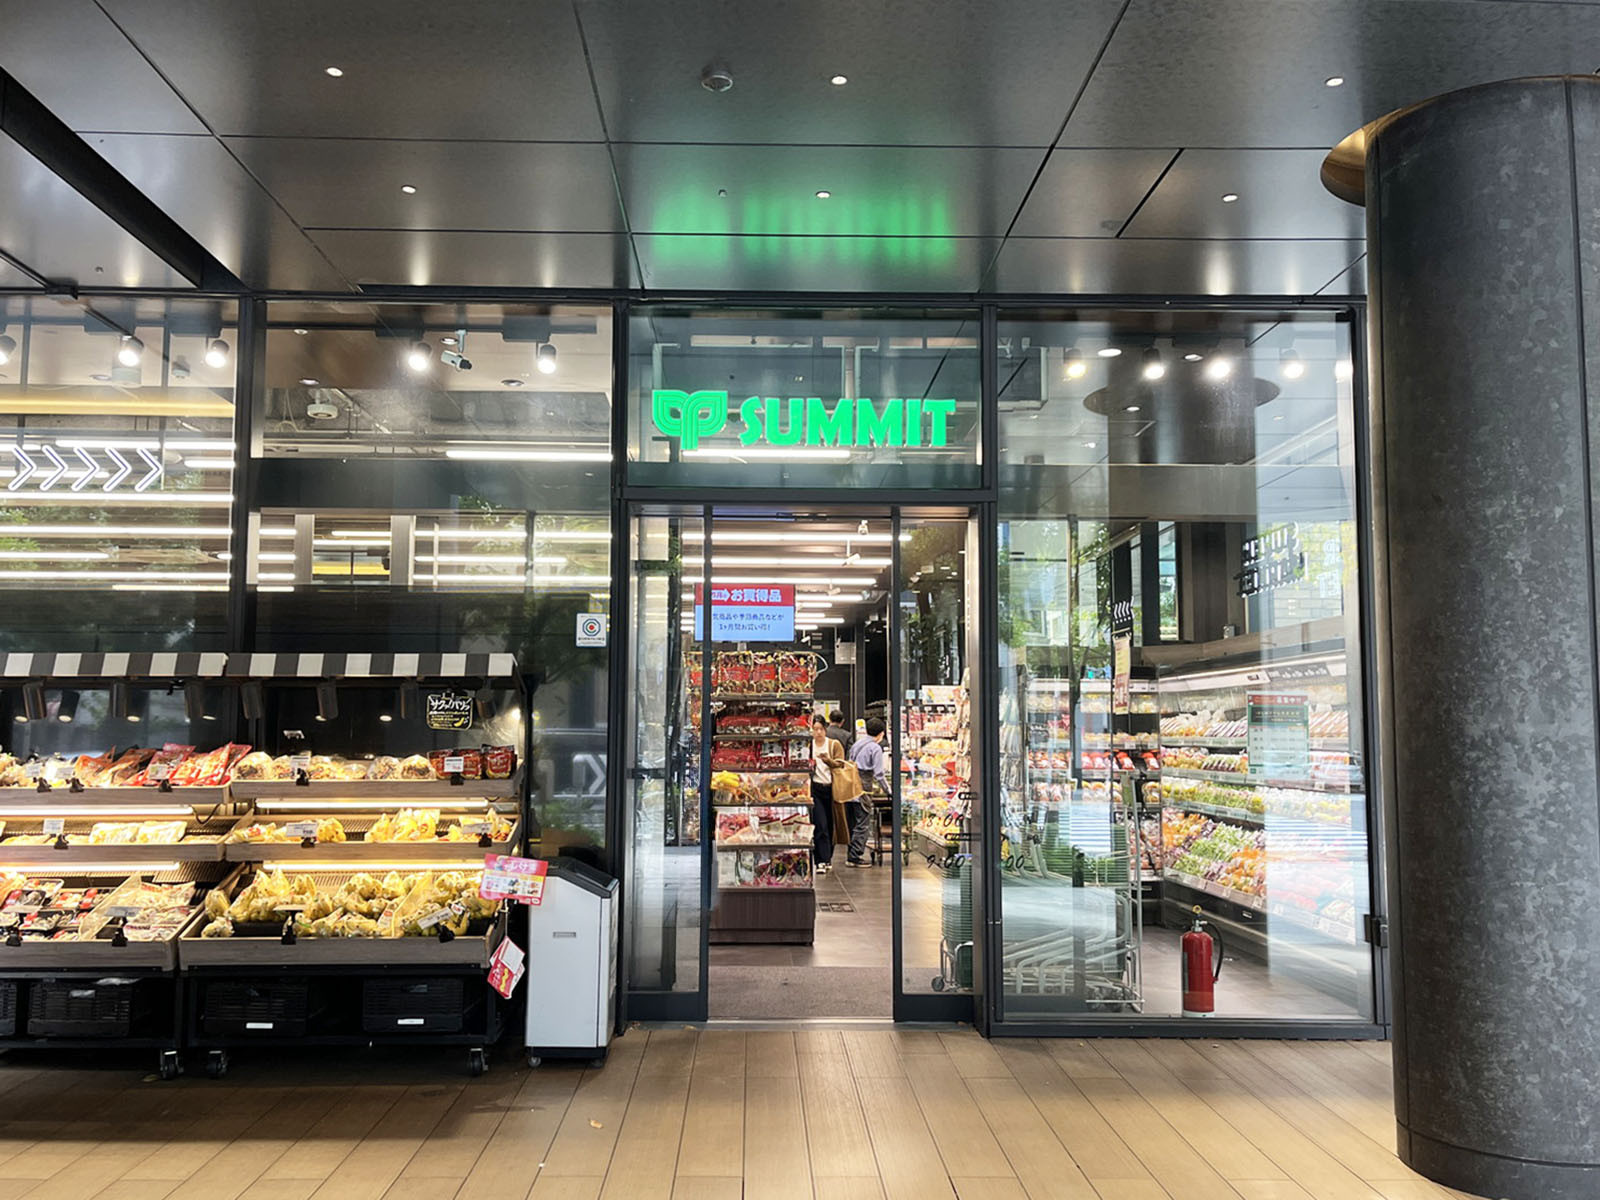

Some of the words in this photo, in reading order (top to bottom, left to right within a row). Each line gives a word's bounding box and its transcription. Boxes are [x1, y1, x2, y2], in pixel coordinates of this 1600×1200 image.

[739, 396, 956, 447] SUMMIT
[731, 589, 782, 602] お買得品
[926, 813, 965, 827] 8:00
[926, 855, 966, 868] 9:00
